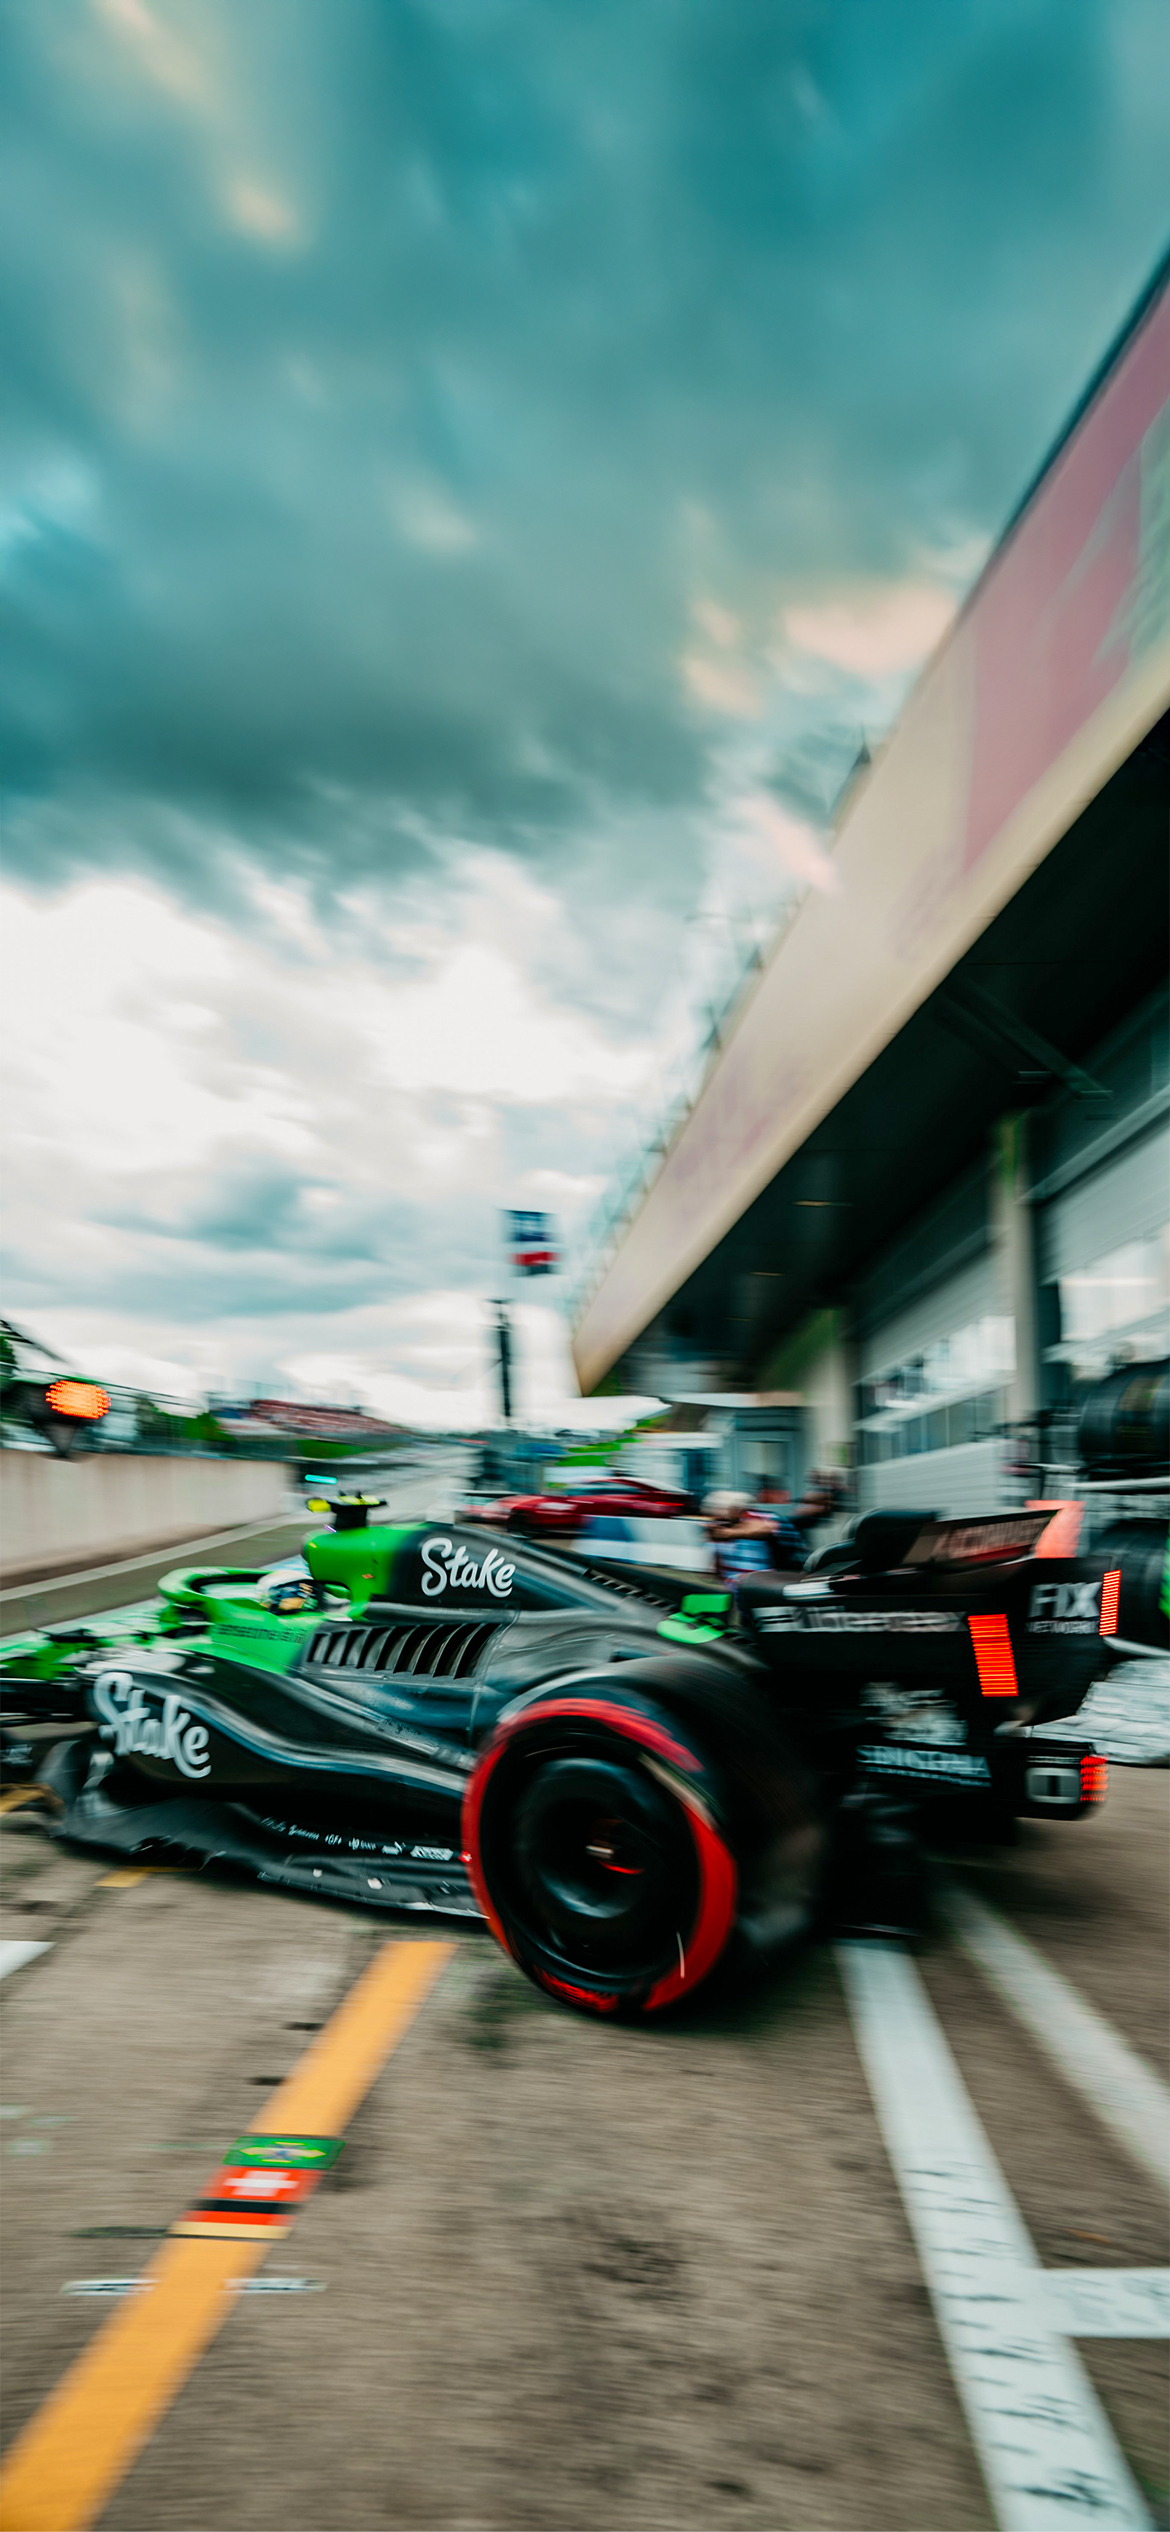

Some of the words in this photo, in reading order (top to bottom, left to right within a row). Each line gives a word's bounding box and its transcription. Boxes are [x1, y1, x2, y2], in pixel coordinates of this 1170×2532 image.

[421, 1537, 516, 1598] Stake
[1028, 1582, 1103, 1618] FIX
[93, 1672, 212, 1779] Stake
